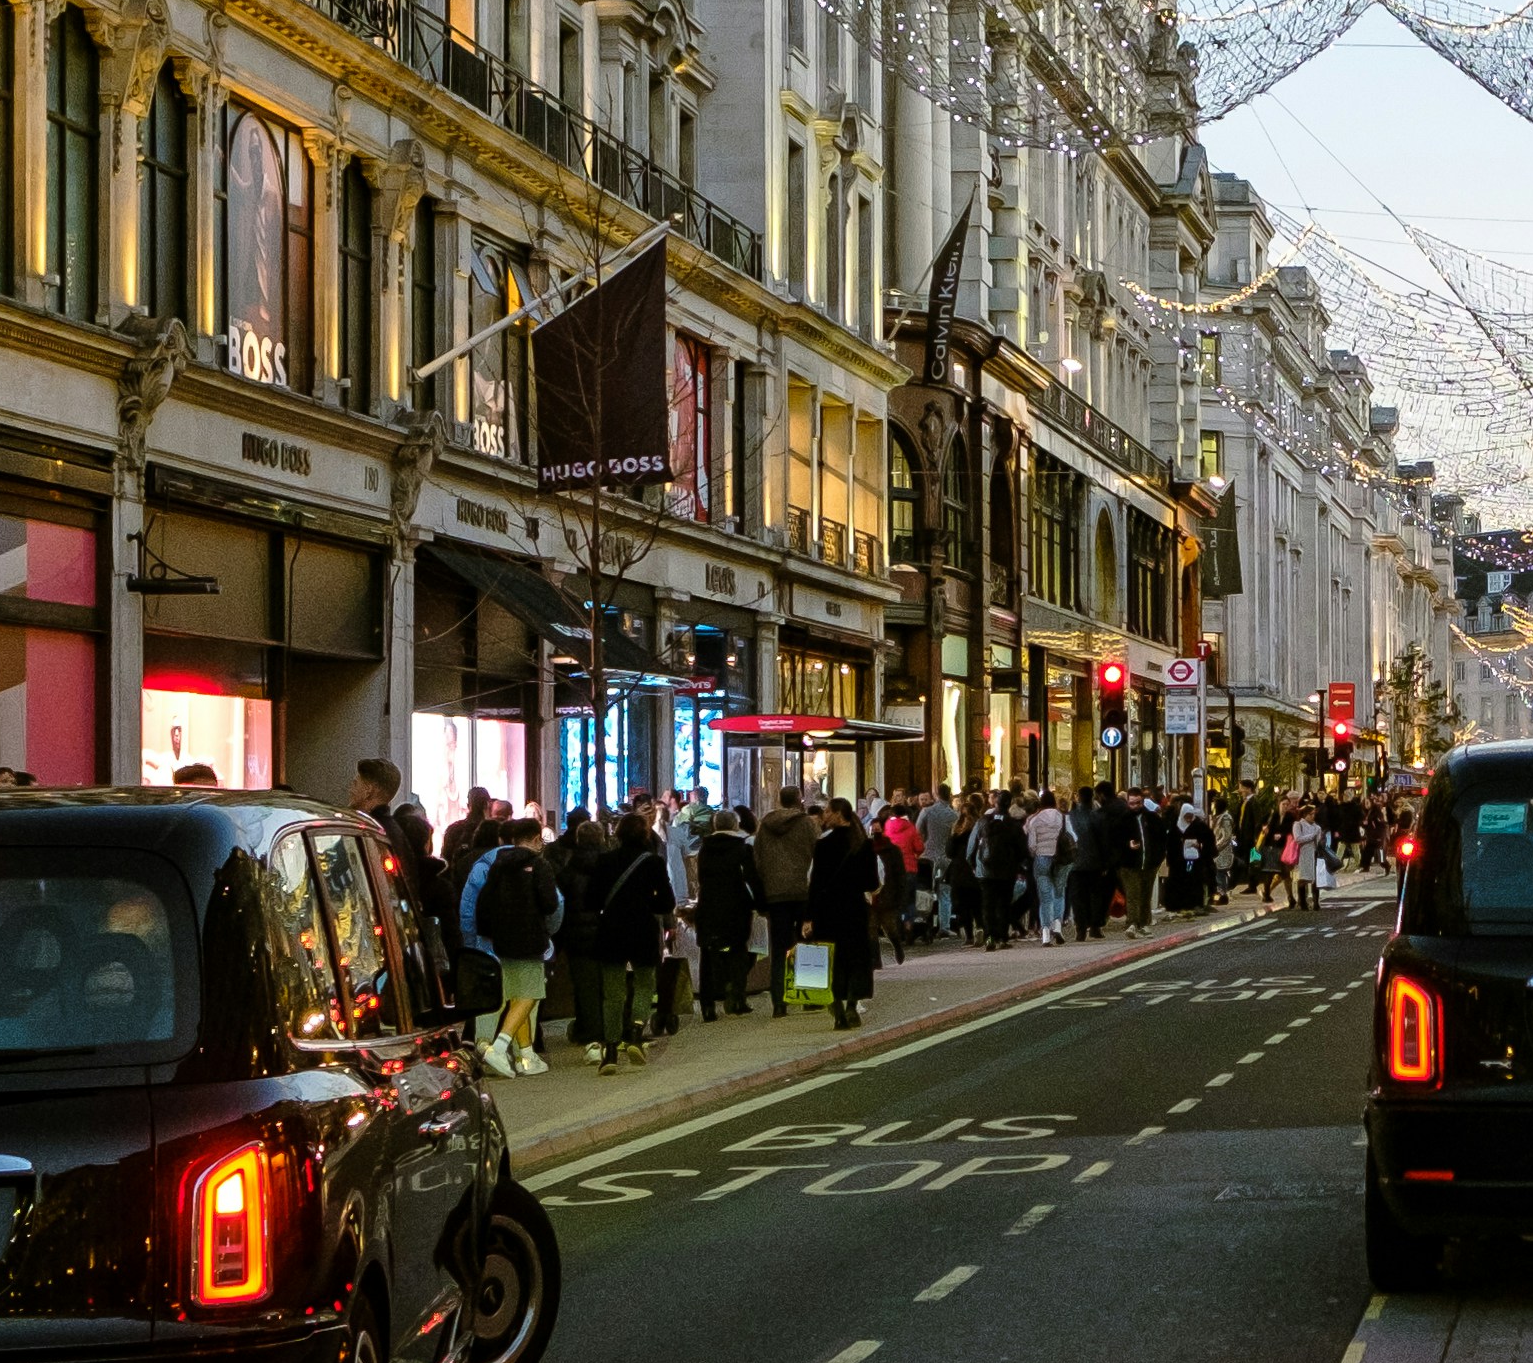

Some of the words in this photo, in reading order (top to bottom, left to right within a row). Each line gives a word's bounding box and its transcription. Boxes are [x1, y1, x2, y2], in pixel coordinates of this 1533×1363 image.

[229, 325, 287, 386] BOSS
[931, 304, 953, 380] Calvin
[242, 432, 279, 468] HUGO
[280, 442, 311, 476] BOSS
[473, 418, 505, 458] BOSS
[542, 460, 602, 482] HUGO
[608, 455, 665, 474] BOSS
[1197, 642, 1209, 656] T
[1047, 988, 1327, 1010] STOP
[1119, 975, 1315, 993] BUS
[720, 1115, 1078, 1152] BUS
[540, 1154, 1073, 1206] STOP
